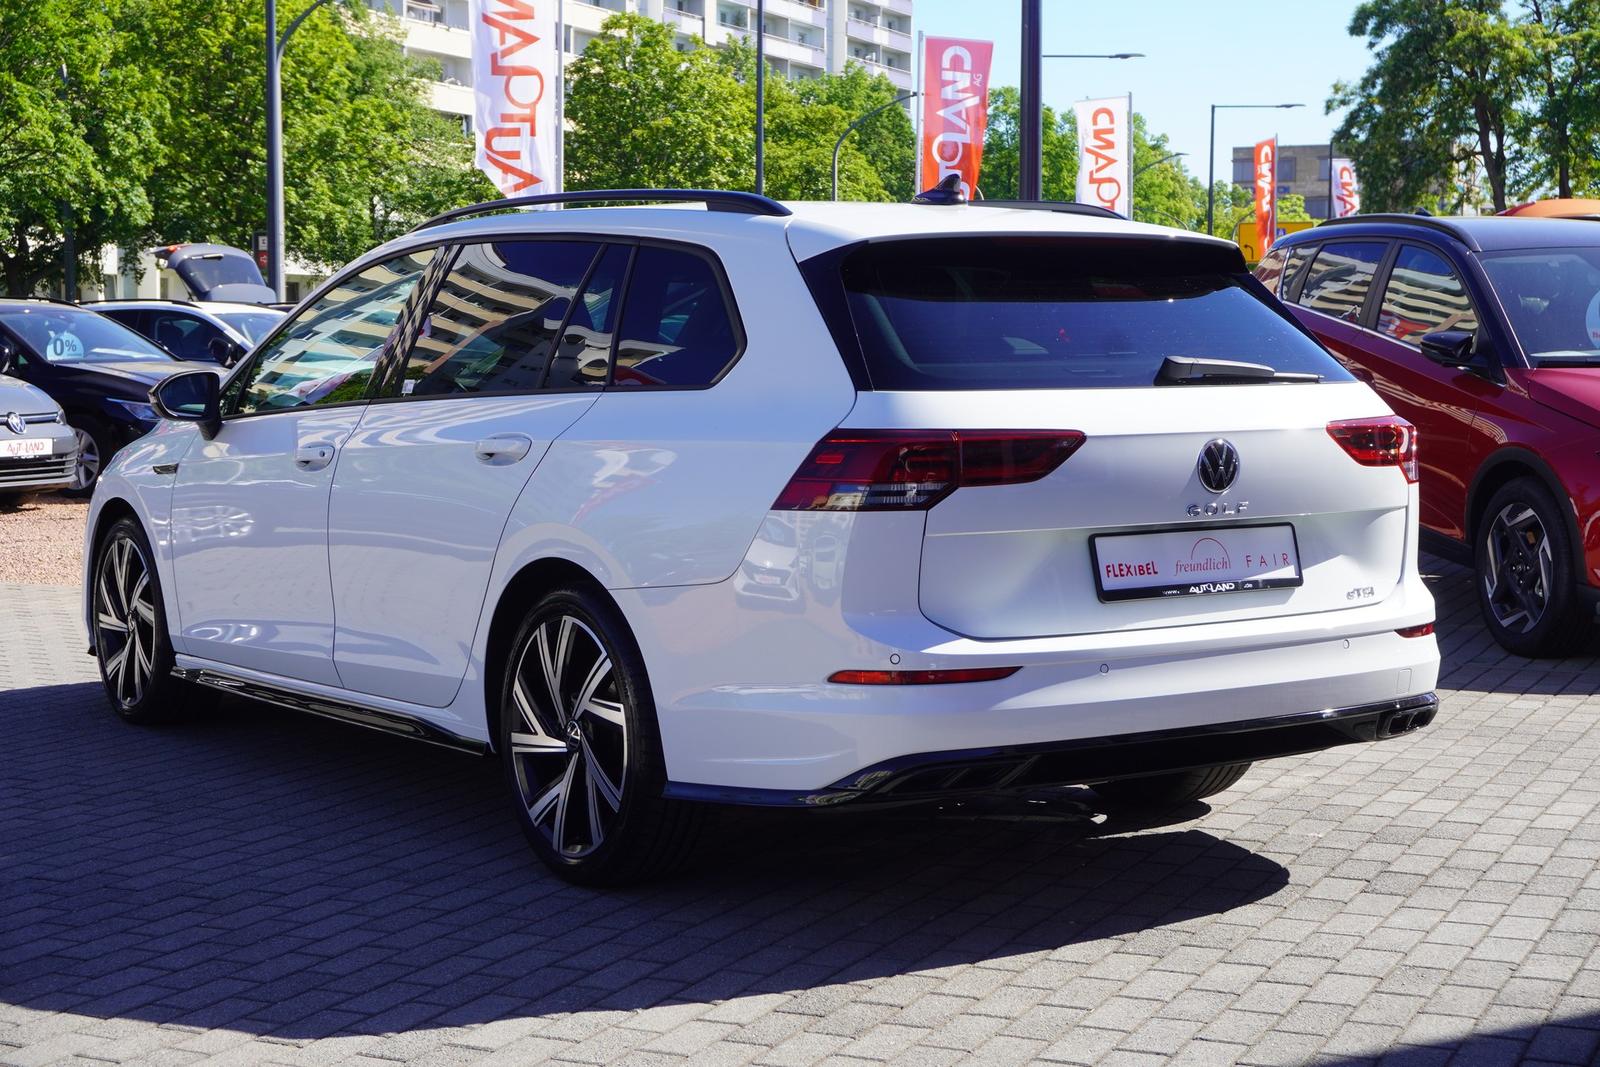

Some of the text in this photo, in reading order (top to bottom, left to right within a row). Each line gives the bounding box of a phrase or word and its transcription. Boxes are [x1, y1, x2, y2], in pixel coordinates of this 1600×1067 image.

[973, 73, 983, 87] AG
[53, 337, 77, 356] 0%
[1186, 501, 1249, 517] GOLF
[1174, 556, 1231, 577] freundlich
[1245, 552, 1290, 568] FAIR
